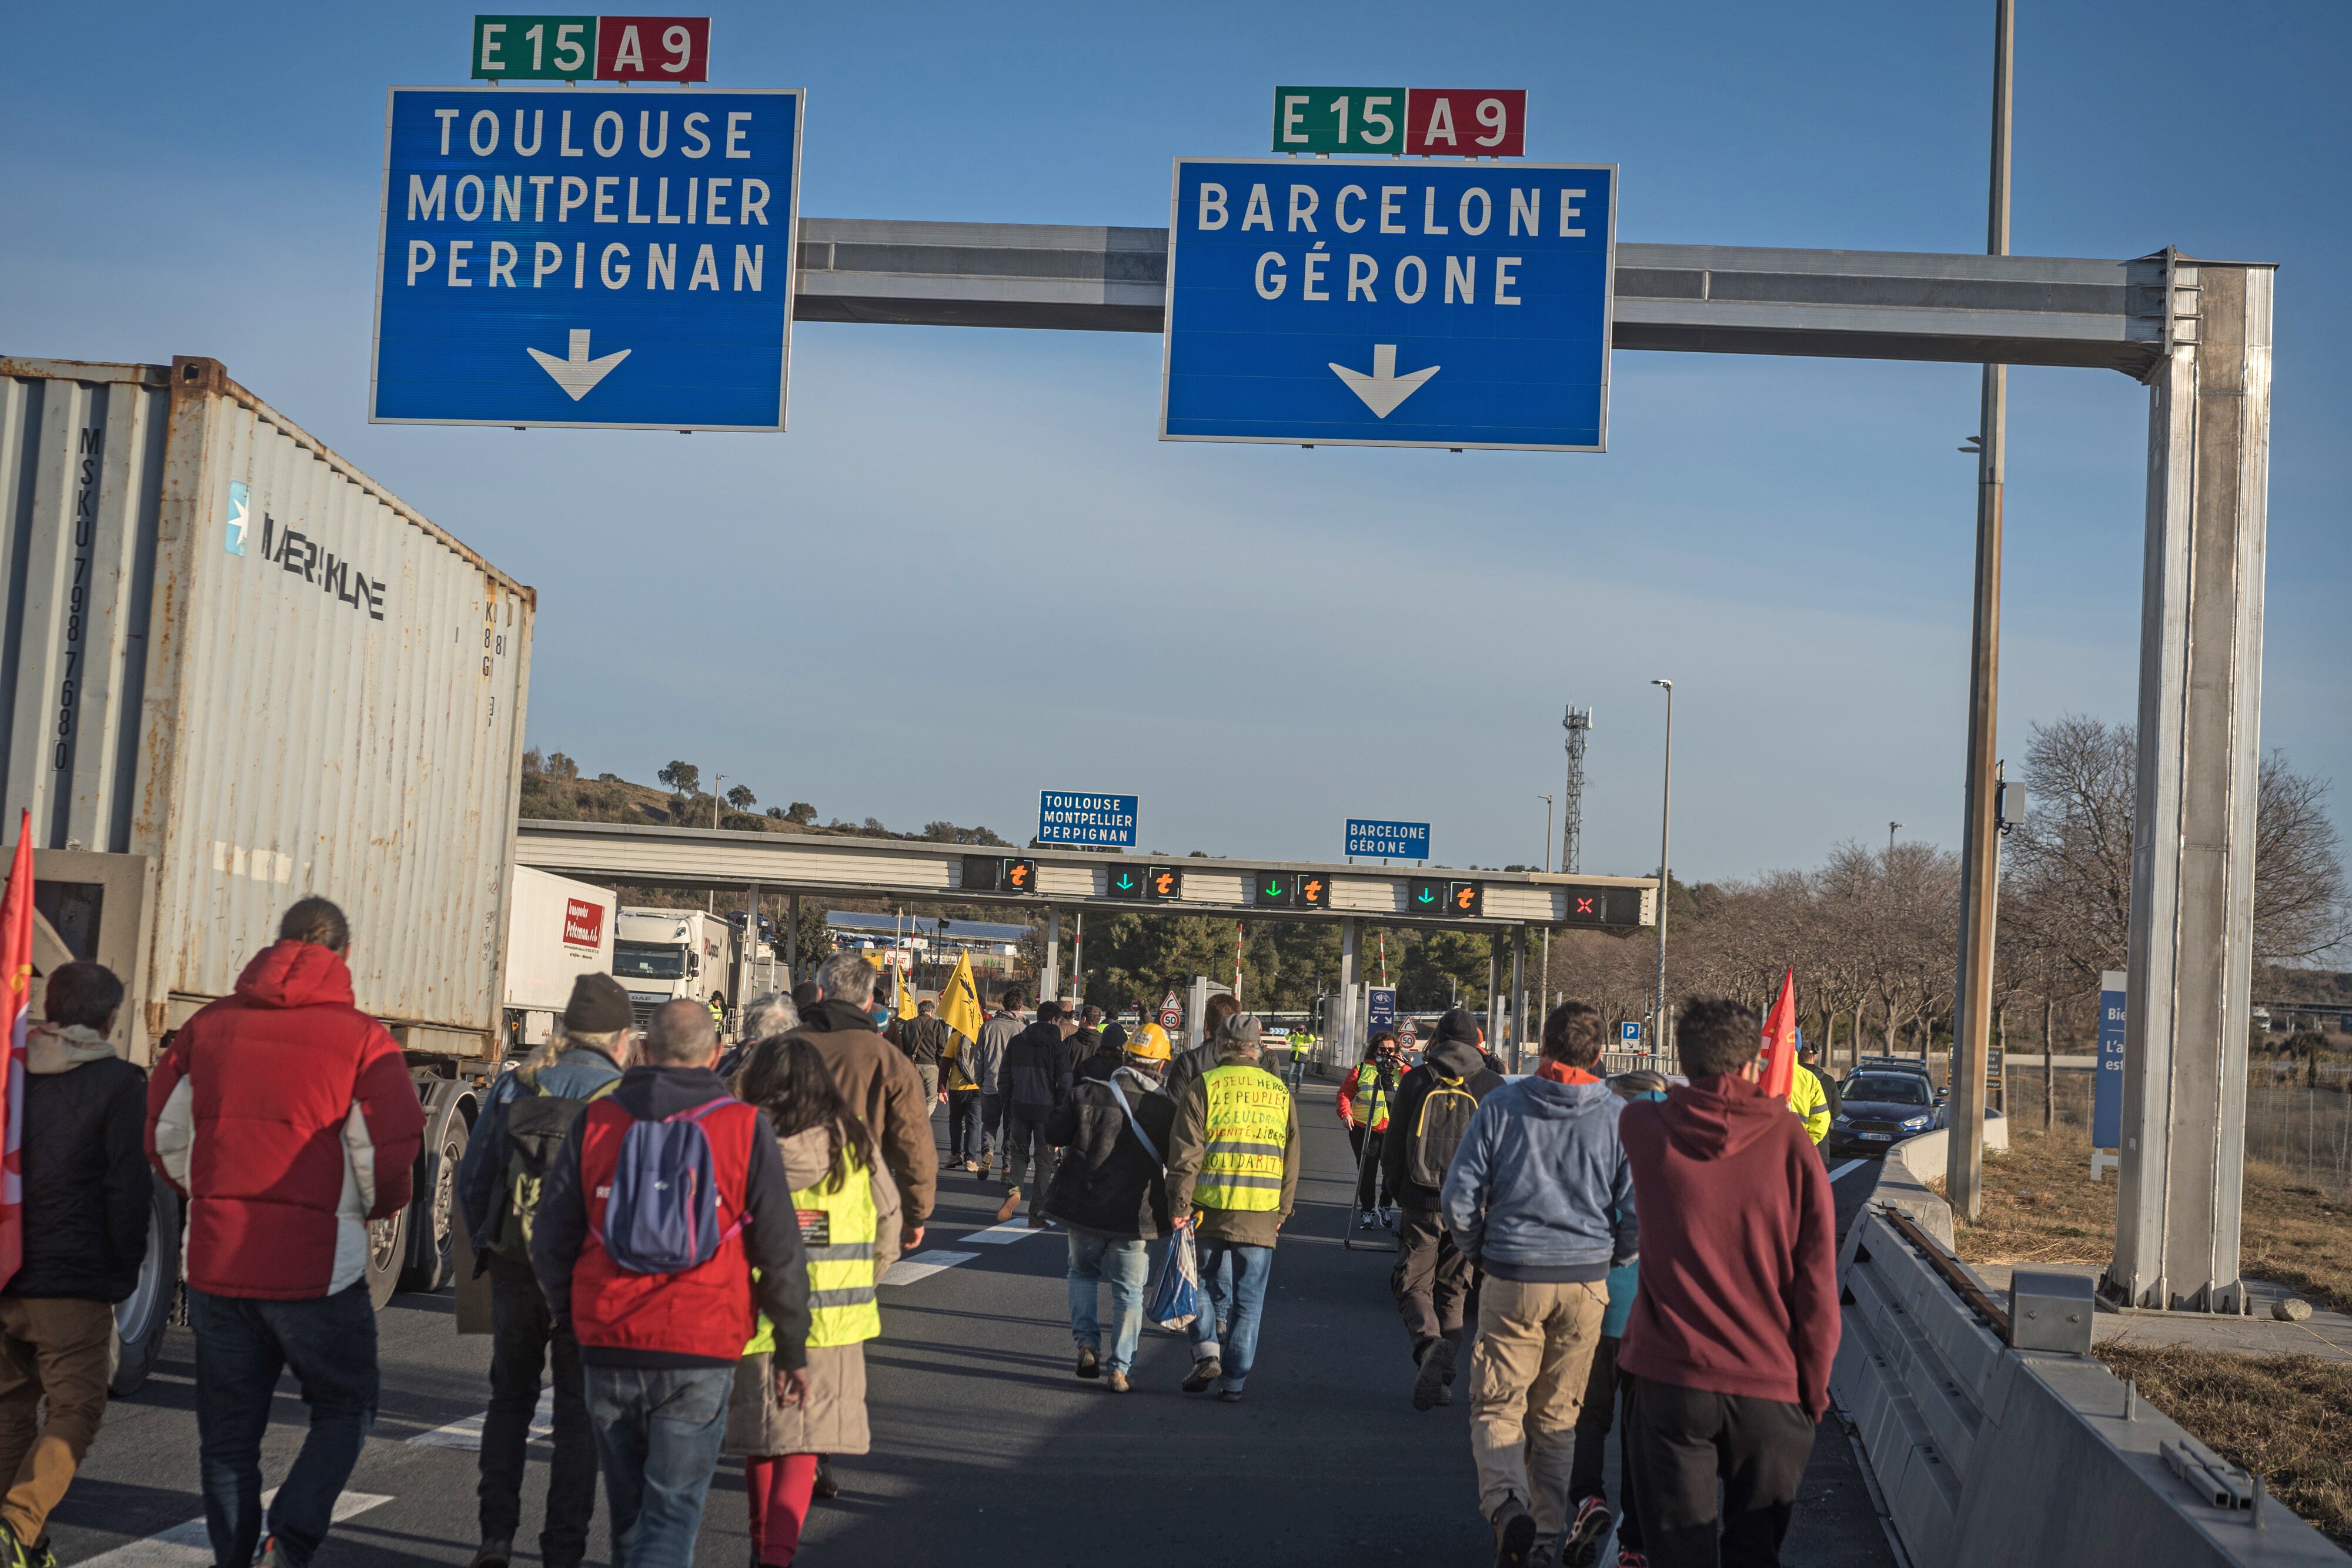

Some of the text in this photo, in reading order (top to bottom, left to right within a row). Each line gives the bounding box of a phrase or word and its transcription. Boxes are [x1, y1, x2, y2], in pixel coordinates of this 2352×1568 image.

[480, 24, 586, 71] E 15
[613, 25, 691, 73] A 9
[1282, 95, 1394, 145] E 15
[1424, 98, 1506, 147] A 9
[434, 109, 753, 159] TOULOUSE
[406, 174, 771, 226] MONTPELLIER
[1198, 182, 1587, 238] BARCELONE
[406, 239, 764, 292] PERPIGNAN
[1254, 241, 1523, 306] GÉRONE
[1045, 795, 1121, 811] TOULOUSE
[1044, 810, 1132, 827] MONTPELLIER
[1043, 825, 1128, 842] PERPIGNAN
[1350, 824, 1425, 840] BARCELONE
[1349, 837, 1406, 854] GÉRONE
[1165, 1016, 1176, 1024] 50
[1627, 1026, 1635, 1037] P
[1402, 1037, 1412, 1045] 50
[1224, 1076, 1253, 1087] SEUL
[1212, 1092, 1230, 1106] LE
